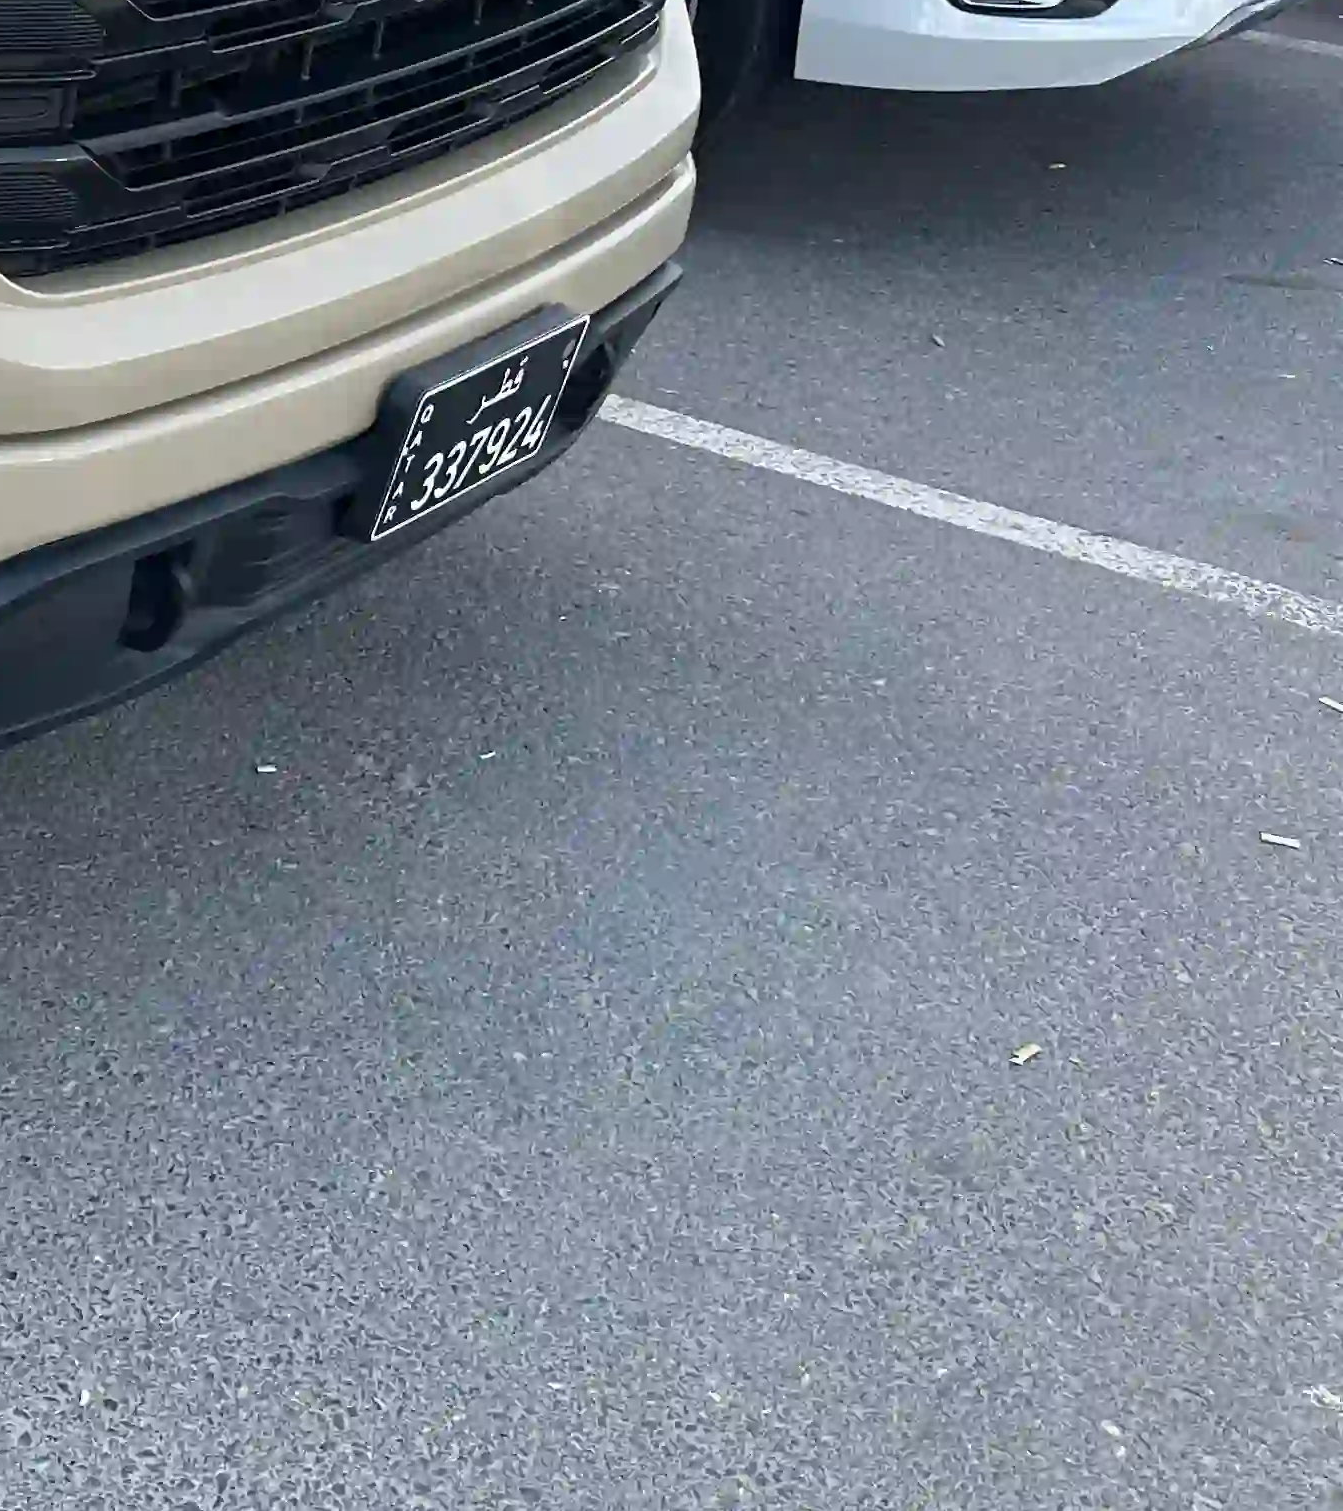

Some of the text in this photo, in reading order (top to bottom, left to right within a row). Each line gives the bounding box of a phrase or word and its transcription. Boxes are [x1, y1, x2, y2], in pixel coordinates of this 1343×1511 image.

[465, 355, 530, 424] قطر
[382, 403, 435, 524] QATAR
[410, 393, 553, 512] 337924
